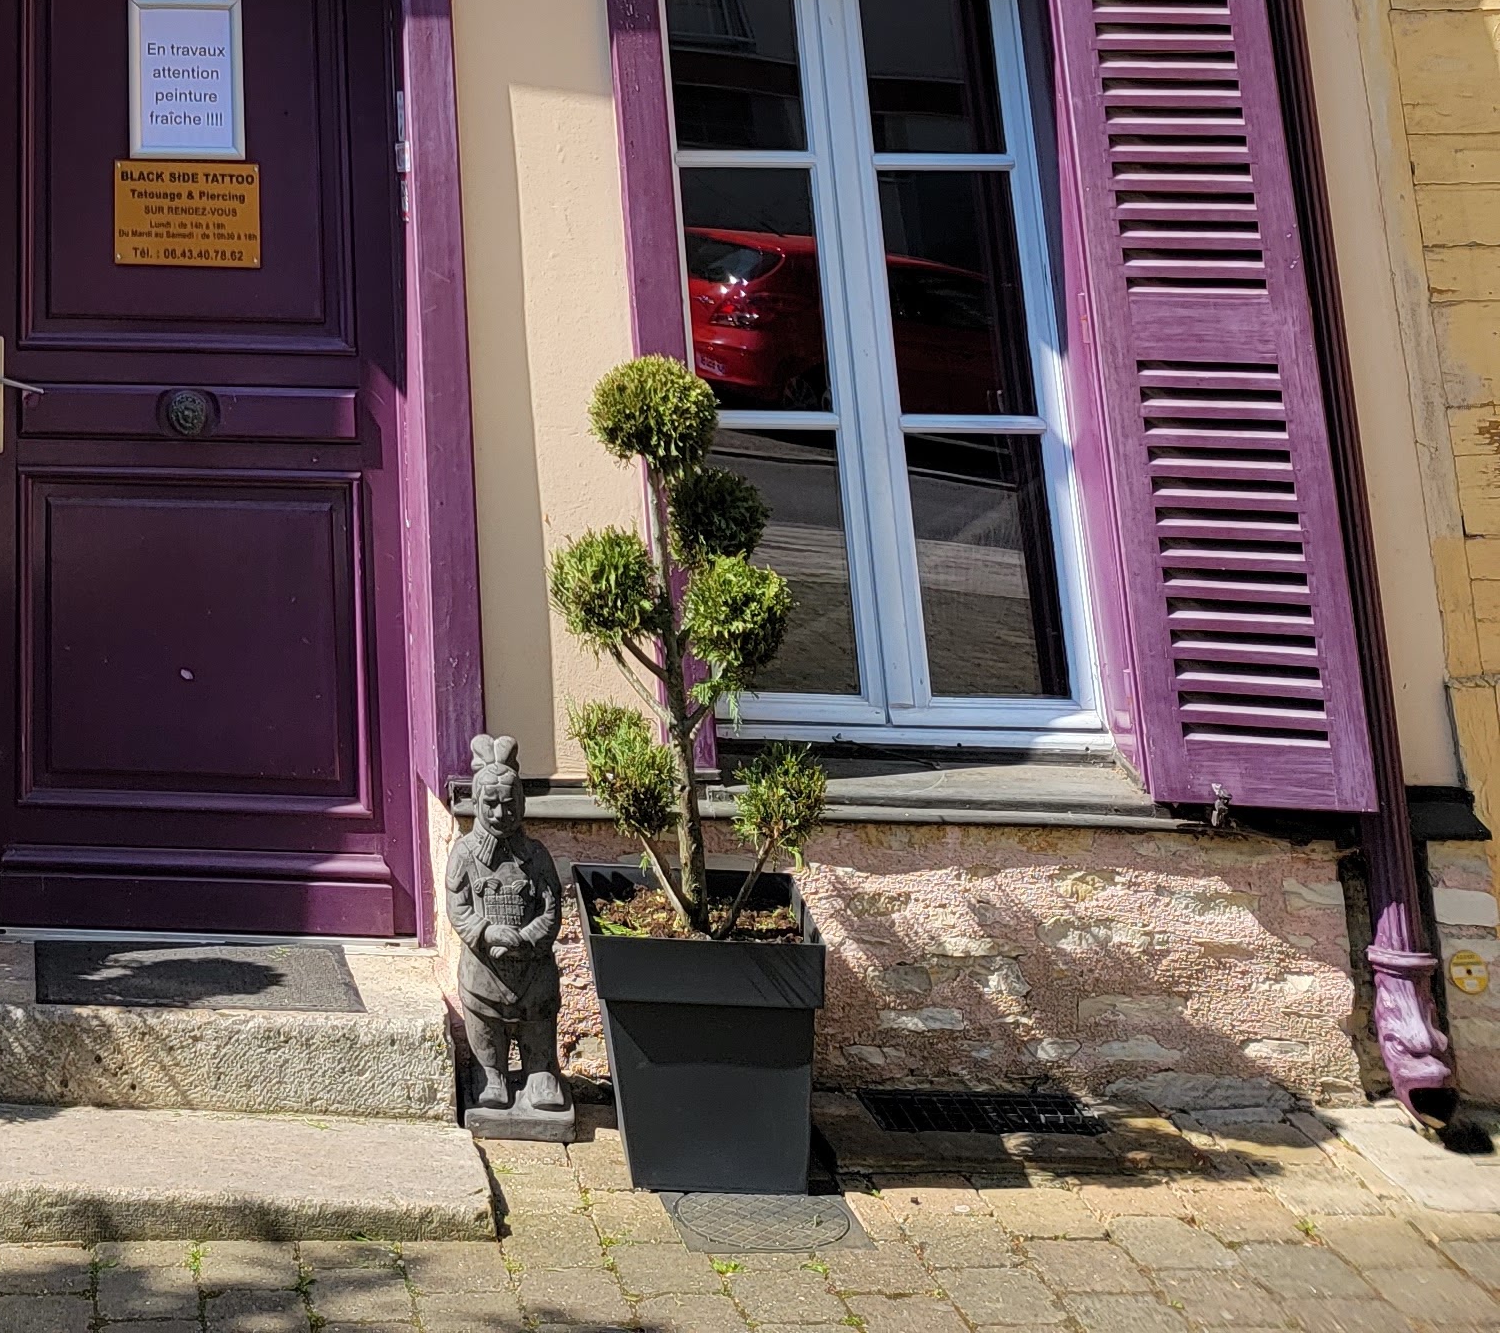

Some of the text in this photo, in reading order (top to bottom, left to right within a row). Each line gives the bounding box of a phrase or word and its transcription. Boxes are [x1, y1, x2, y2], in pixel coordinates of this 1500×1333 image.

[147, 42, 226, 58] En travaux
[152, 65, 220, 80] attention
[155, 88, 218, 105] peinture
[149, 110, 202, 126] fraîche
[120, 170, 255, 185] BLACK SIDE TATTOO
[130, 189, 246, 204] Tatouage & Piercing
[144, 205, 238, 217] SUR RENDEZ-VOUS
[118, 229, 130, 237] Du
[132, 247, 153, 259] Tél.
